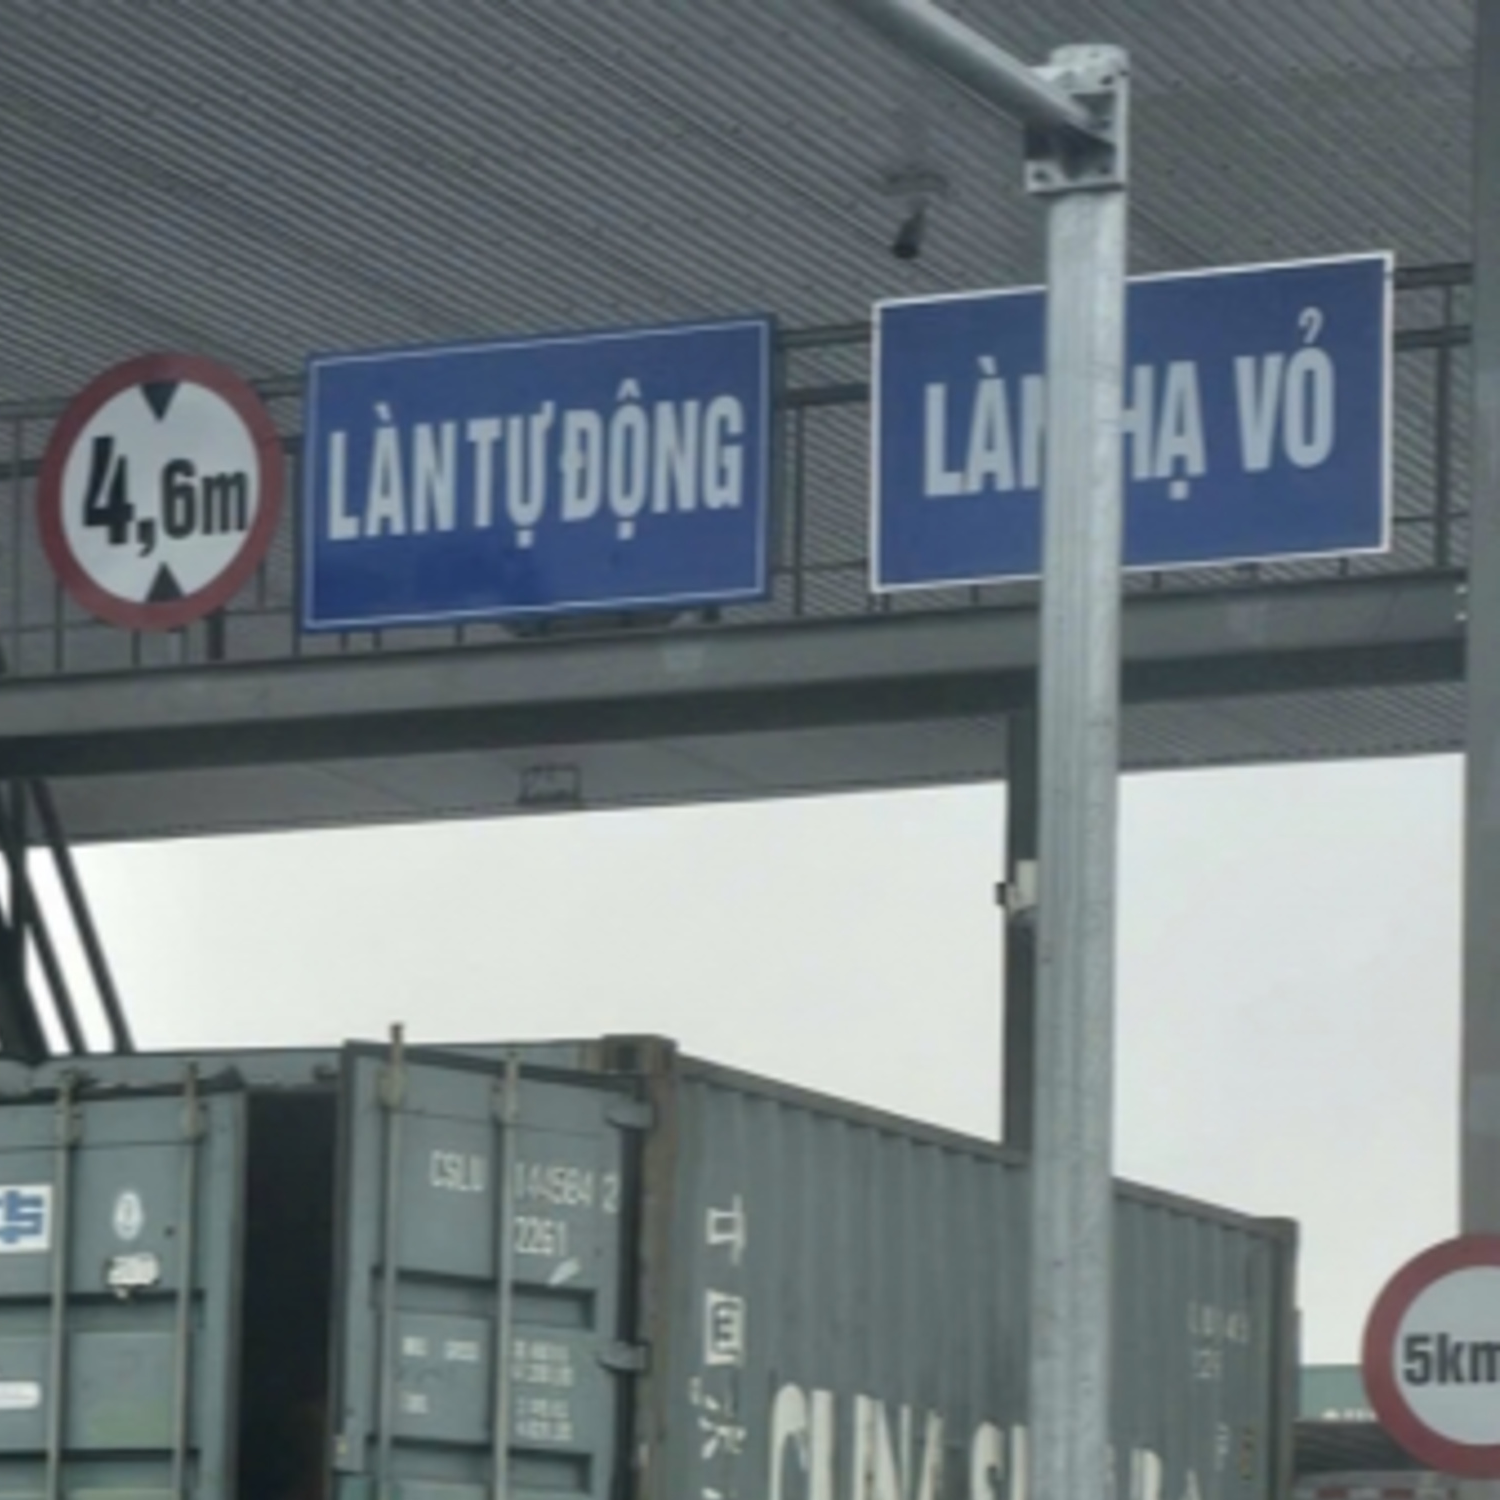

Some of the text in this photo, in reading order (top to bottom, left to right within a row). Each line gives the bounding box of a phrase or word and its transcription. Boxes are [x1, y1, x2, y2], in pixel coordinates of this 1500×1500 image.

[326, 378, 745, 549] LÀN TỰ ĐỘNG
[1234, 306, 1336, 473] VỎ
[81, 435, 249, 557] 4,6m
